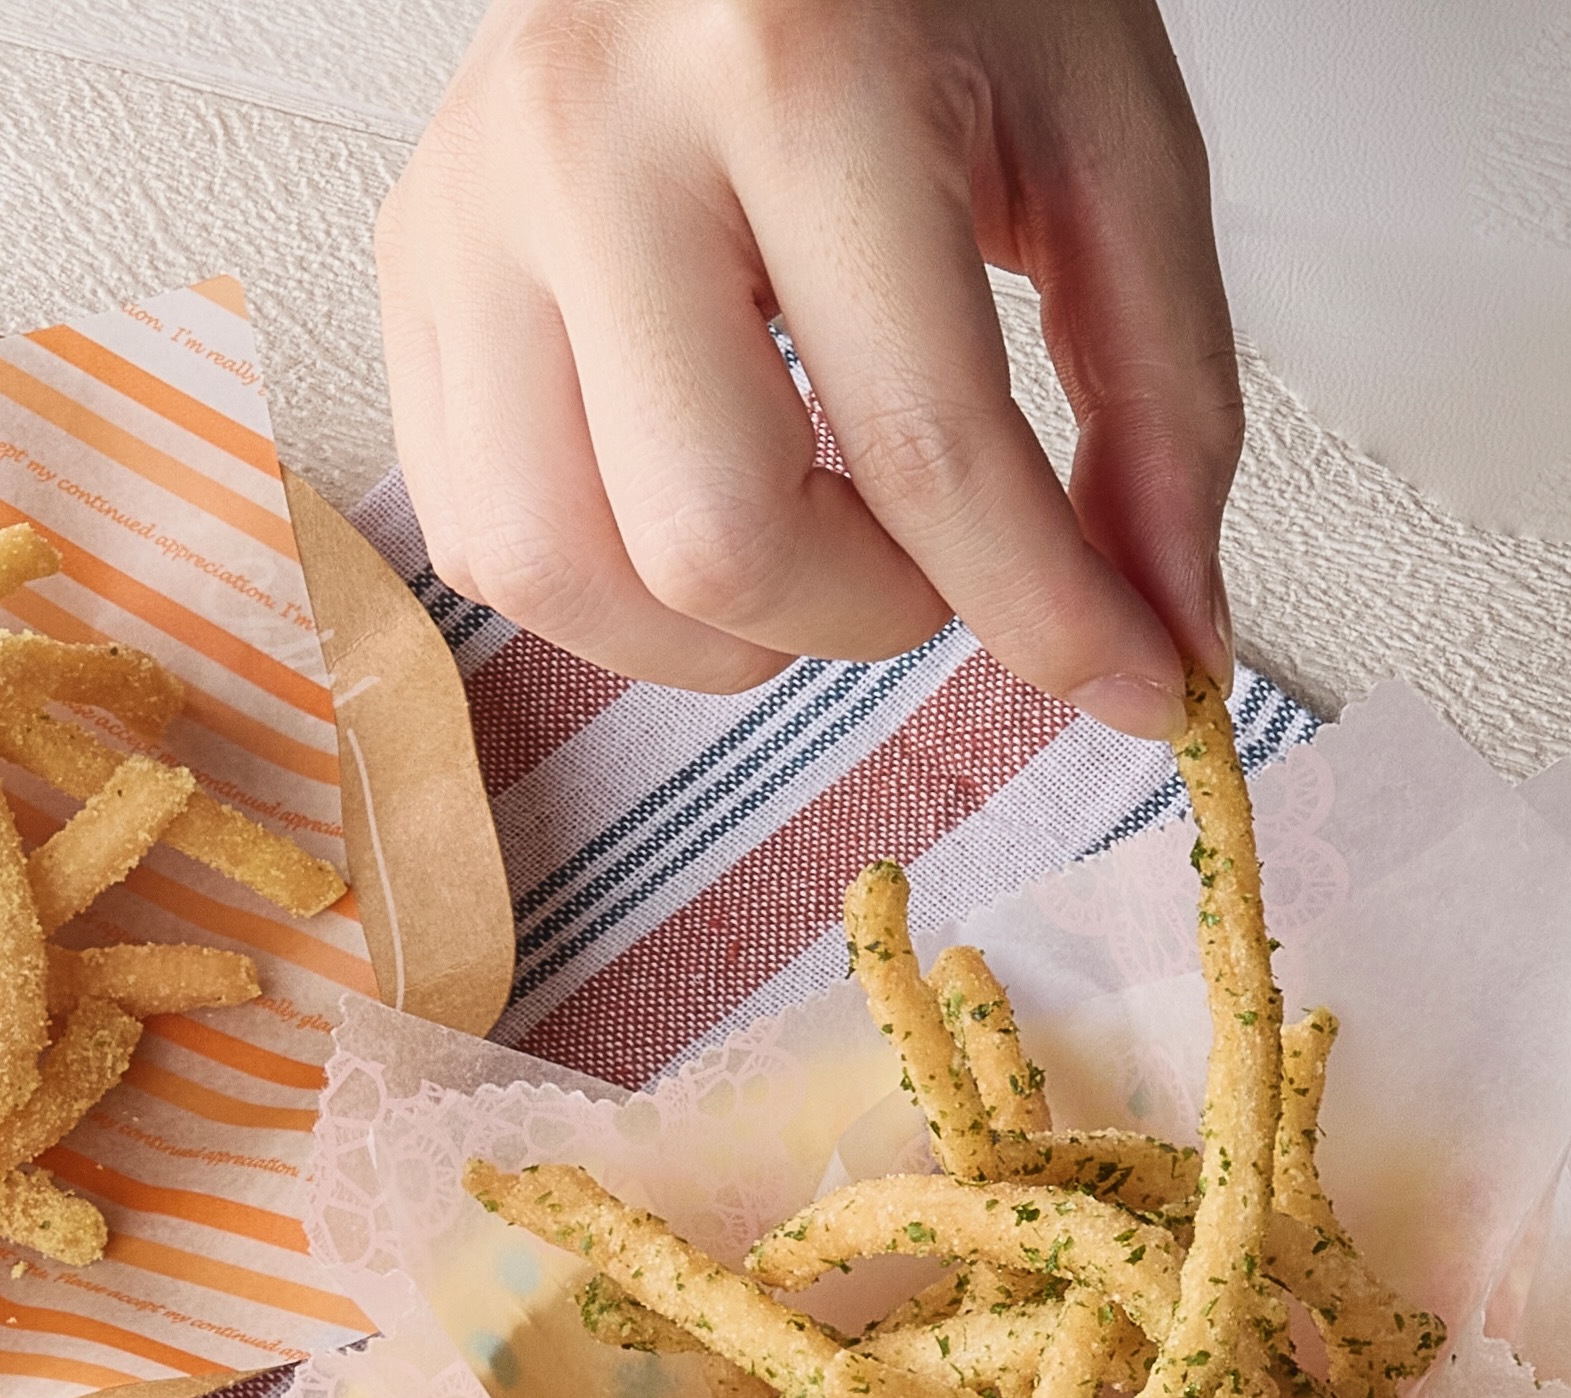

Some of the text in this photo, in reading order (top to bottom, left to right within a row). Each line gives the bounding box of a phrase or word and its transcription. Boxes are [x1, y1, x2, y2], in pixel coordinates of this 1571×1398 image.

[26, 458, 58, 483] my
[56, 476, 156, 539] continued
[154, 528, 276, 610] appreciation.
[189, 1318, 283, 1352] continued
